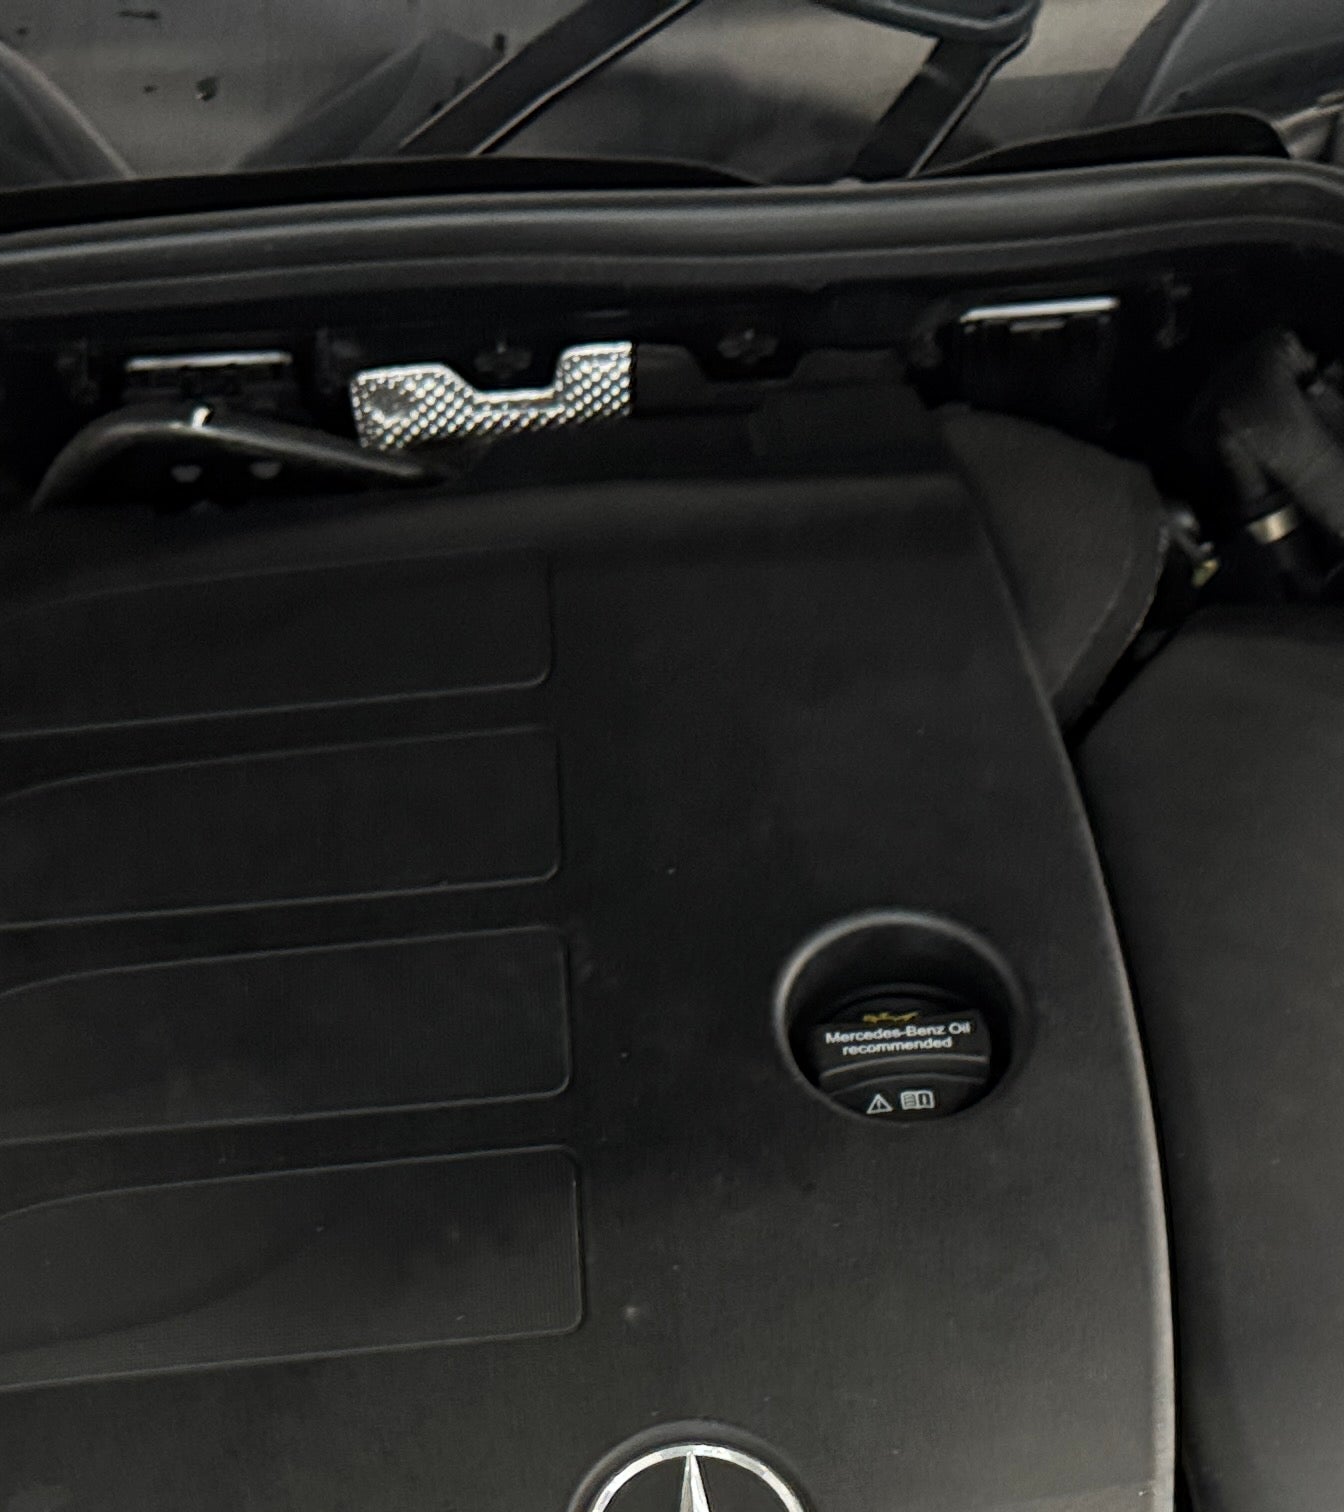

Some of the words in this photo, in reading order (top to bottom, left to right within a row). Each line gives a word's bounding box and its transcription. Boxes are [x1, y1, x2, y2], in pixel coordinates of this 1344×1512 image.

[825, 1024, 945, 1044] Mercedes-Benz
[949, 1021, 971, 1036] Oil
[842, 1036, 952, 1056] recommended
